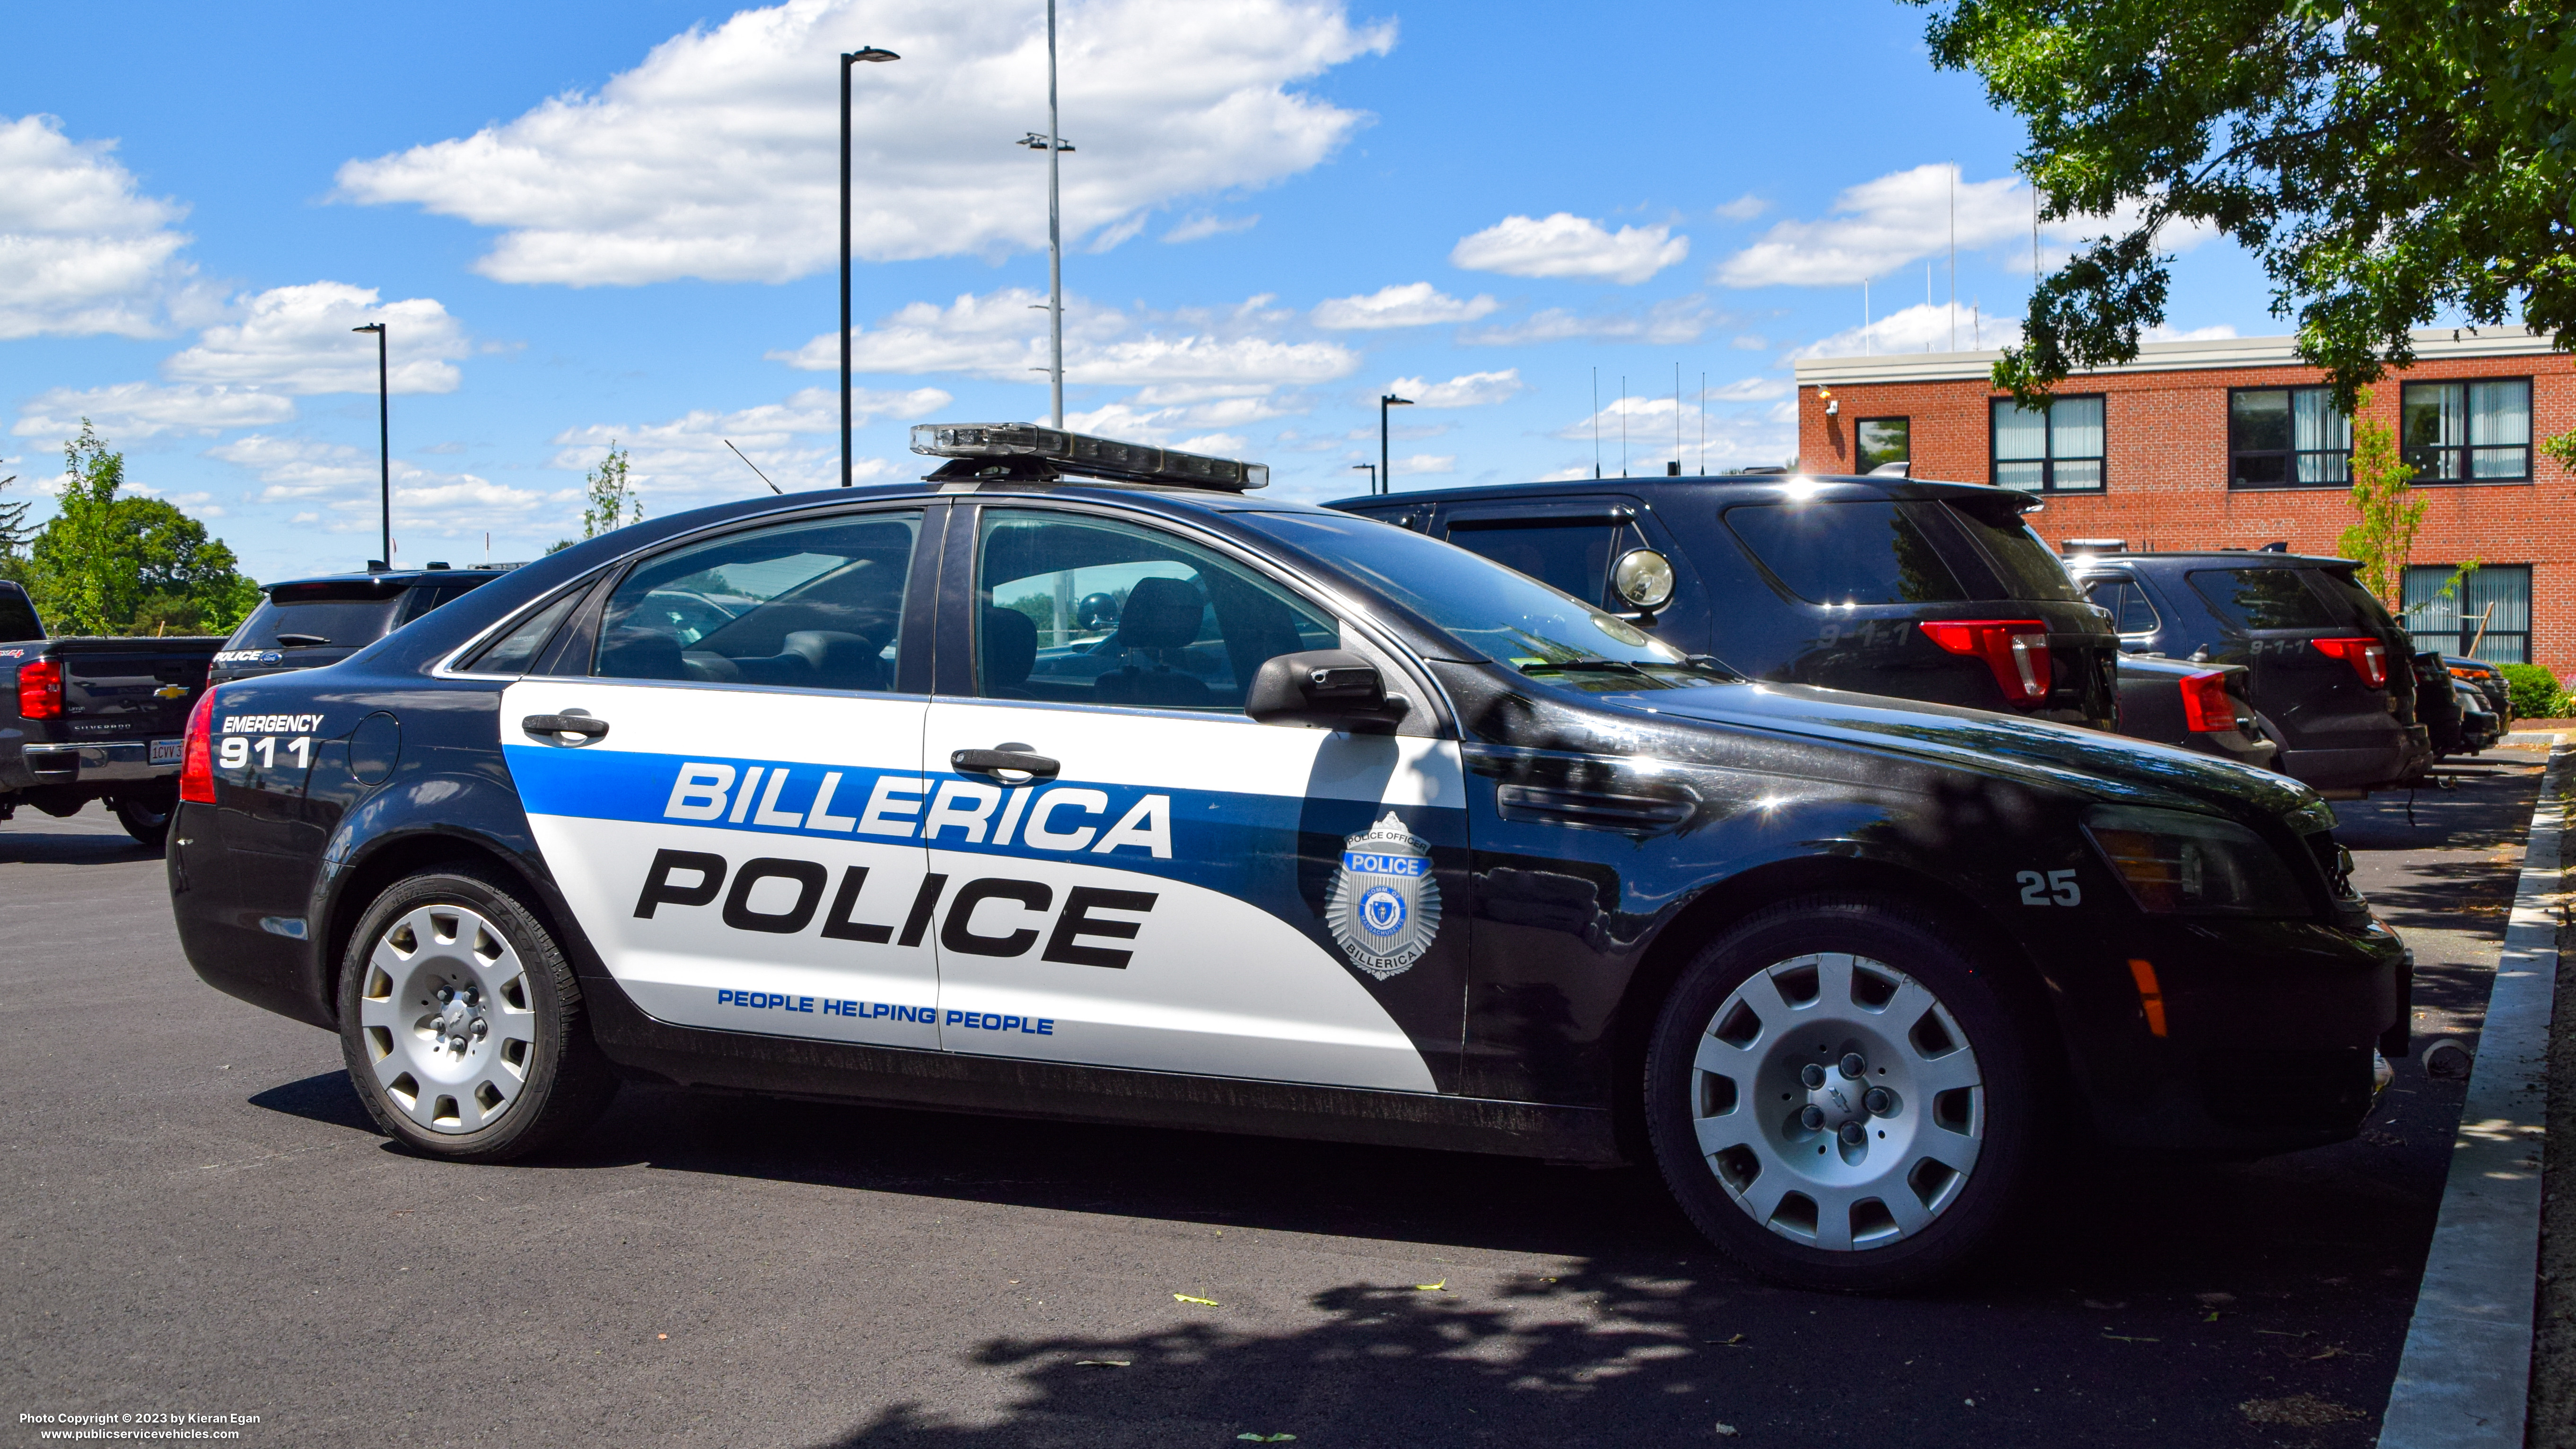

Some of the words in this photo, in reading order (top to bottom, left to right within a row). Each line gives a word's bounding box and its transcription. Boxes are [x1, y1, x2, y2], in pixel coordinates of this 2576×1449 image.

[1816, 621, 1911, 648] 9-1-1
[213, 651, 263, 662] POLICE
[2250, 639, 2306, 655] 9-1-1
[222, 715, 324, 733] EMERGENCY
[153, 746, 174, 759] 1CVV
[219, 737, 310, 768] 911
[664, 762, 1173, 859] BILLERICA
[1348, 832, 1383, 845] POLICE
[1386, 832, 1427, 851] OFFICER
[1352, 855, 1419, 875] POLICE
[1367, 887, 1390, 897] COMM.
[1392, 891, 1401, 899] OF
[2016, 869, 2081, 907] 25
[633, 848, 1159, 969] POLICE
[1360, 915, 1405, 936] MASSACHUSETTS
[1346, 943, 1417, 968] BILLERICA
[718, 989, 815, 1014] PEOPLE
[823, 999, 936, 1024] HELPING
[946, 1010, 1054, 1036] PEOPLE
